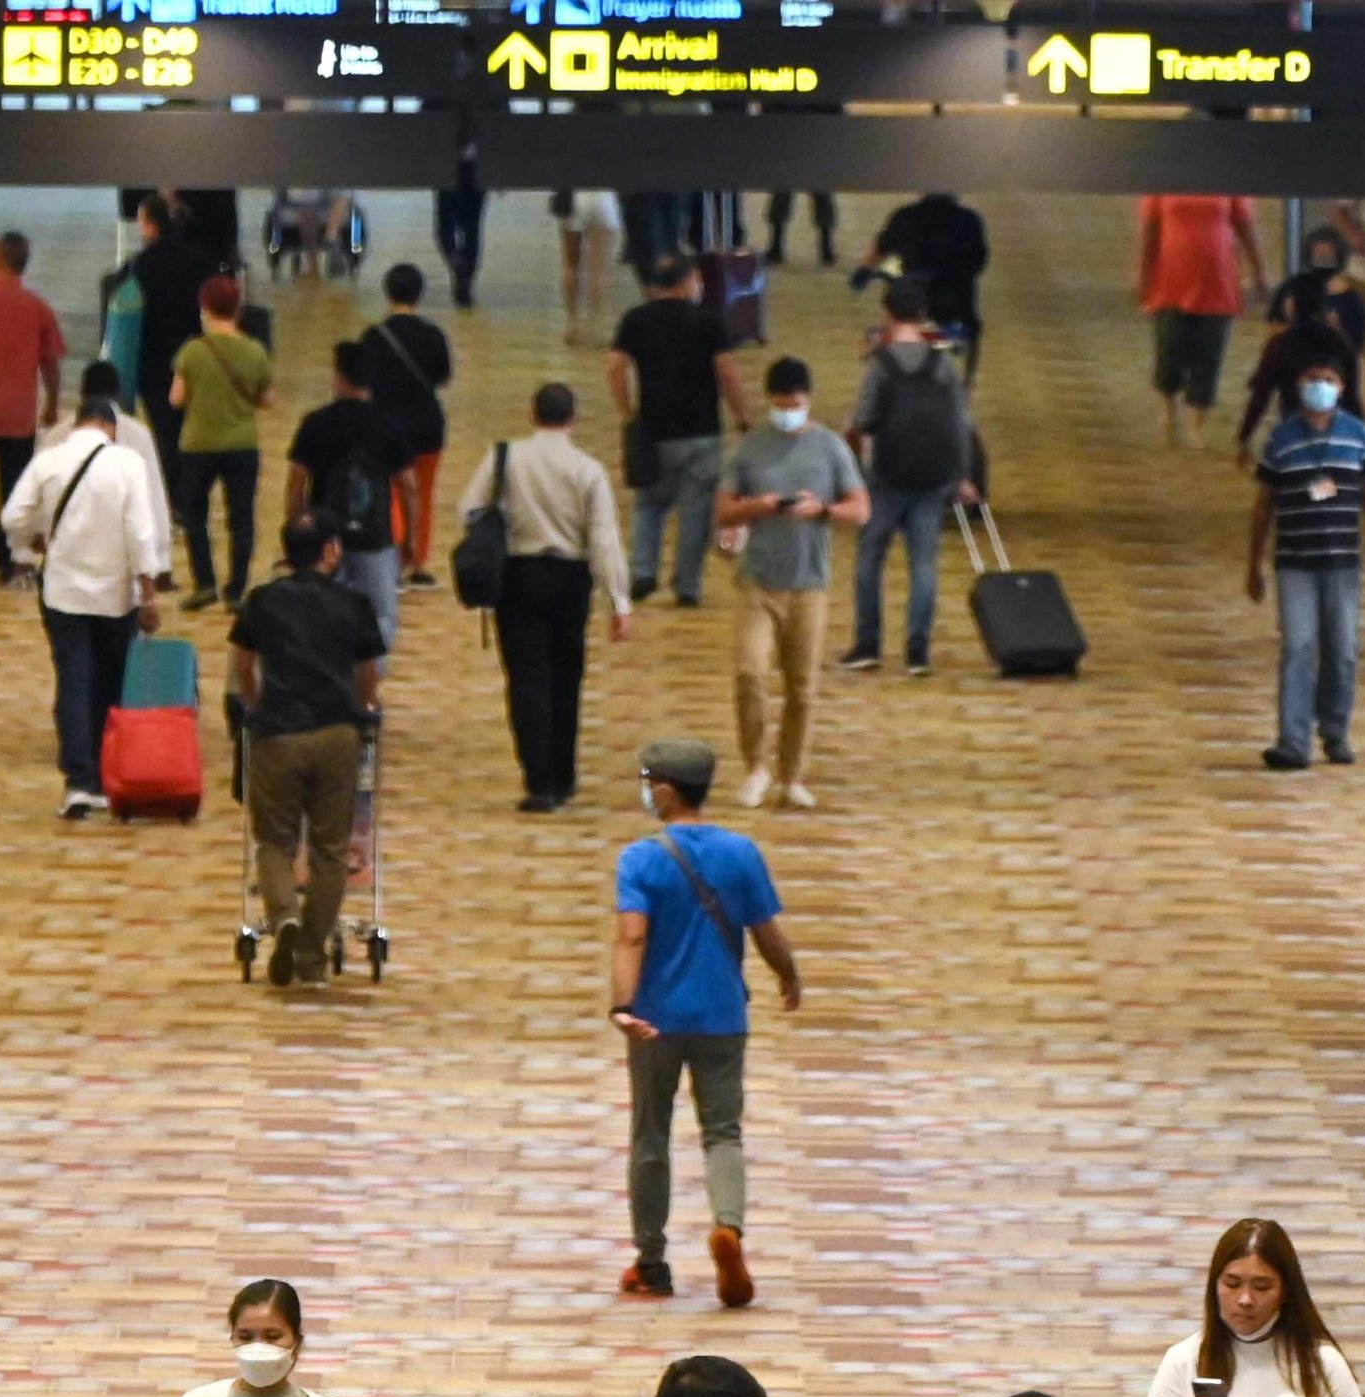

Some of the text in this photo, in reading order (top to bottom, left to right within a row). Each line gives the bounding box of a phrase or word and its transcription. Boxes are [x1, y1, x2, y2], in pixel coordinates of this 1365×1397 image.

[68, 27, 123, 55] D30
[616, 30, 718, 61] Arrival
[68, 57, 119, 86] E20
[1156, 49, 1311, 82] Transfer D
[616, 67, 818, 96] Immigration Hall D
